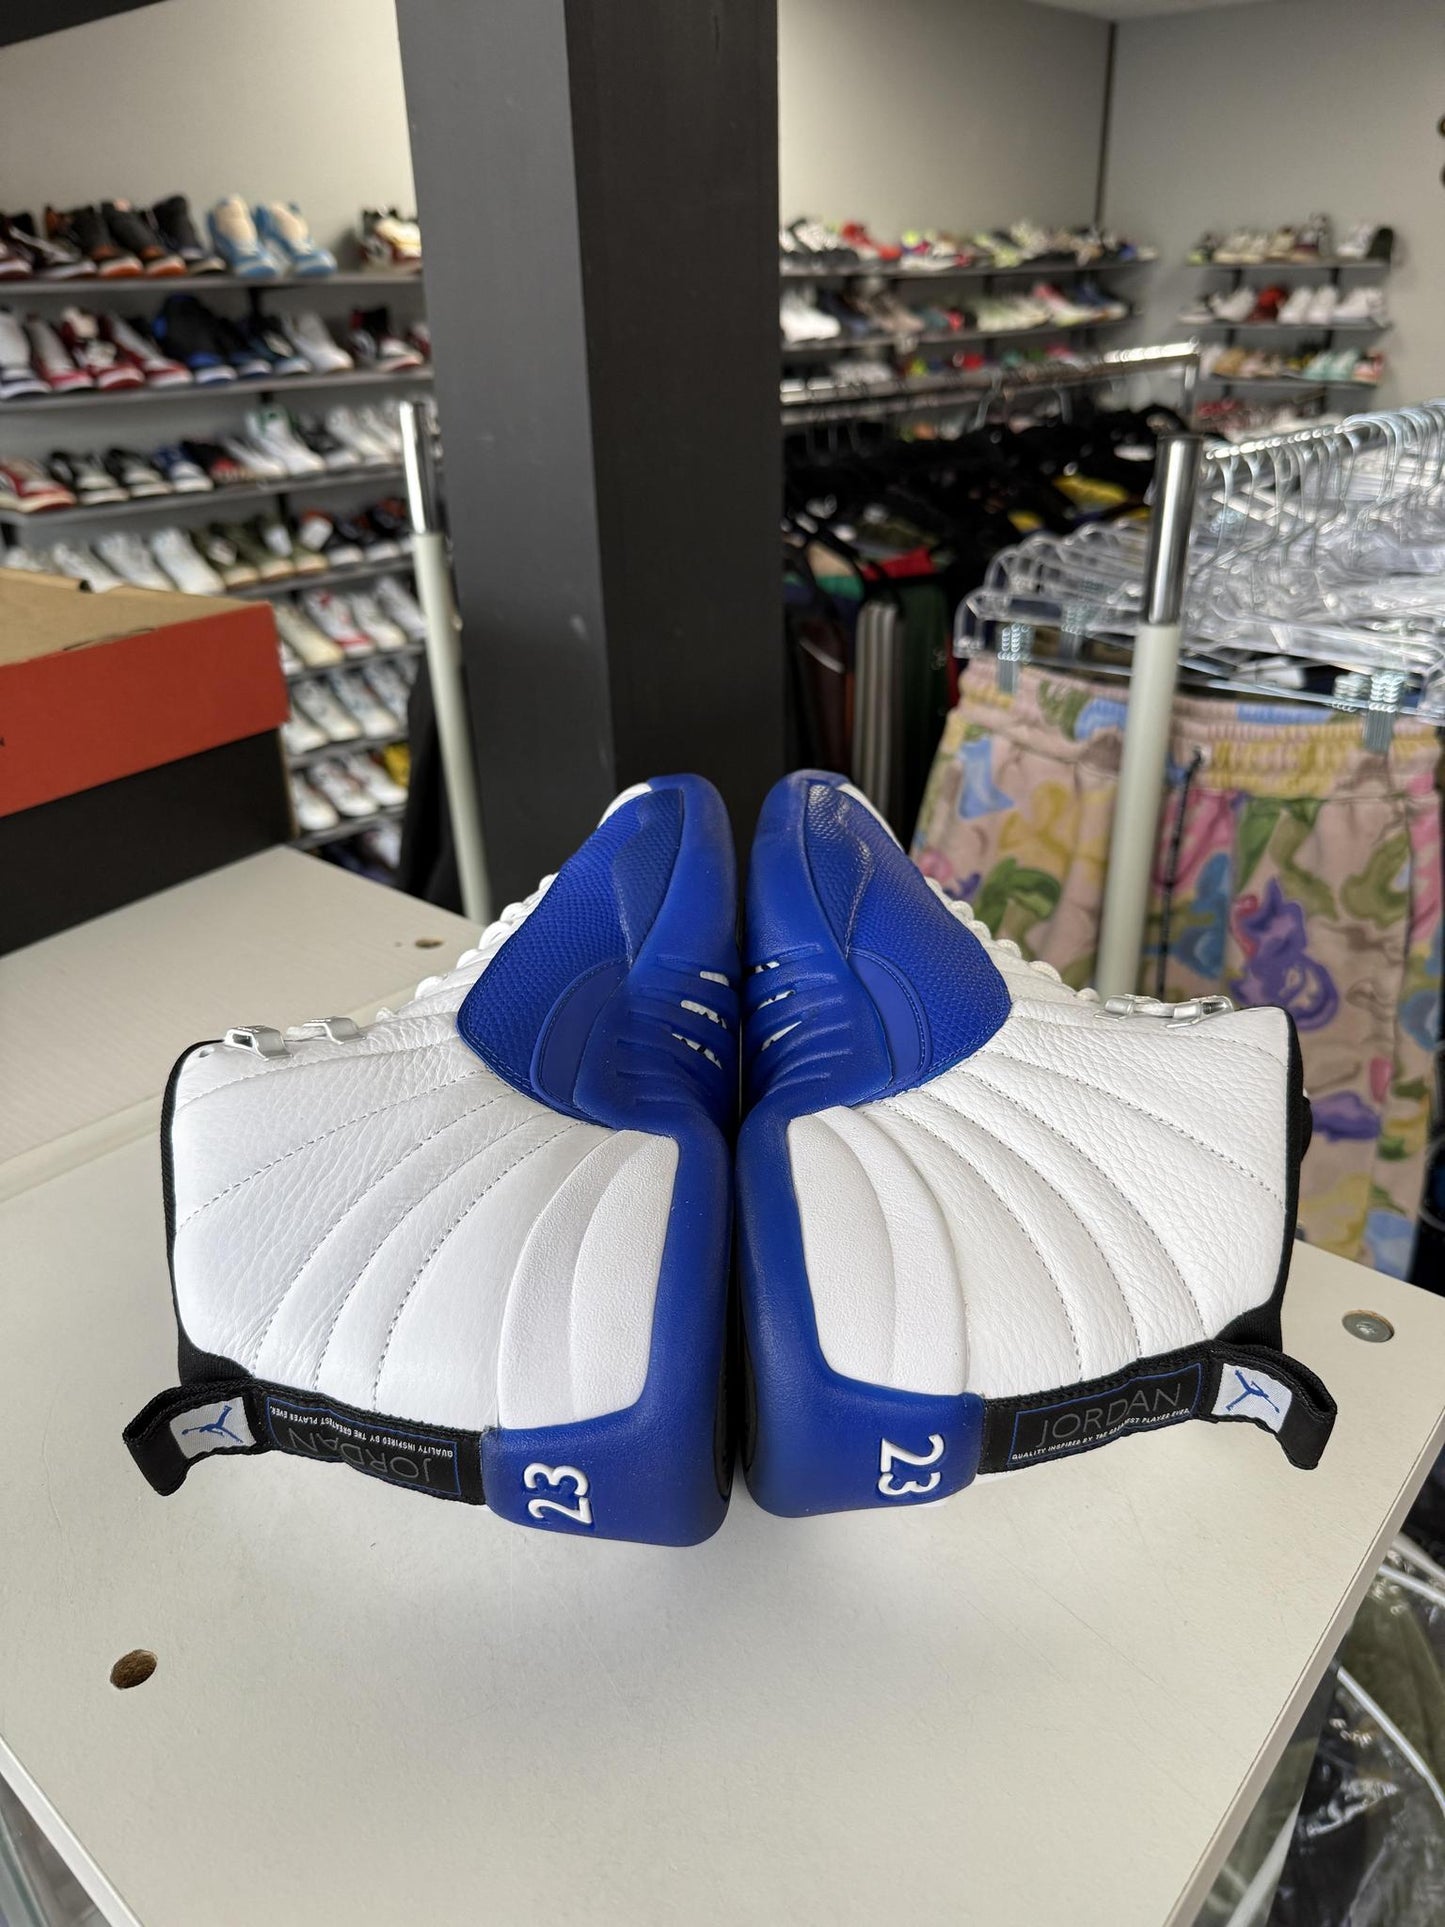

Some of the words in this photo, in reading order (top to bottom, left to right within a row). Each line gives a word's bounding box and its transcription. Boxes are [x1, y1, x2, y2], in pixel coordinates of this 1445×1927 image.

[289, 1413, 318, 1425] PLAYER
[1035, 1383, 1180, 1448] JORDAN
[353, 1429, 367, 1441] THE
[369, 1434, 381, 1443] BY
[382, 1435, 416, 1451] INSPIRED
[288, 1427, 432, 1482] JORDAN
[418, 1445, 454, 1458] QUALITY
[1011, 1447, 1047, 1461] QUALITY
[1047, 1439, 1081, 1453] INSPIRED
[878, 1433, 945, 1496] 23
[523, 1462, 593, 1525] 23
